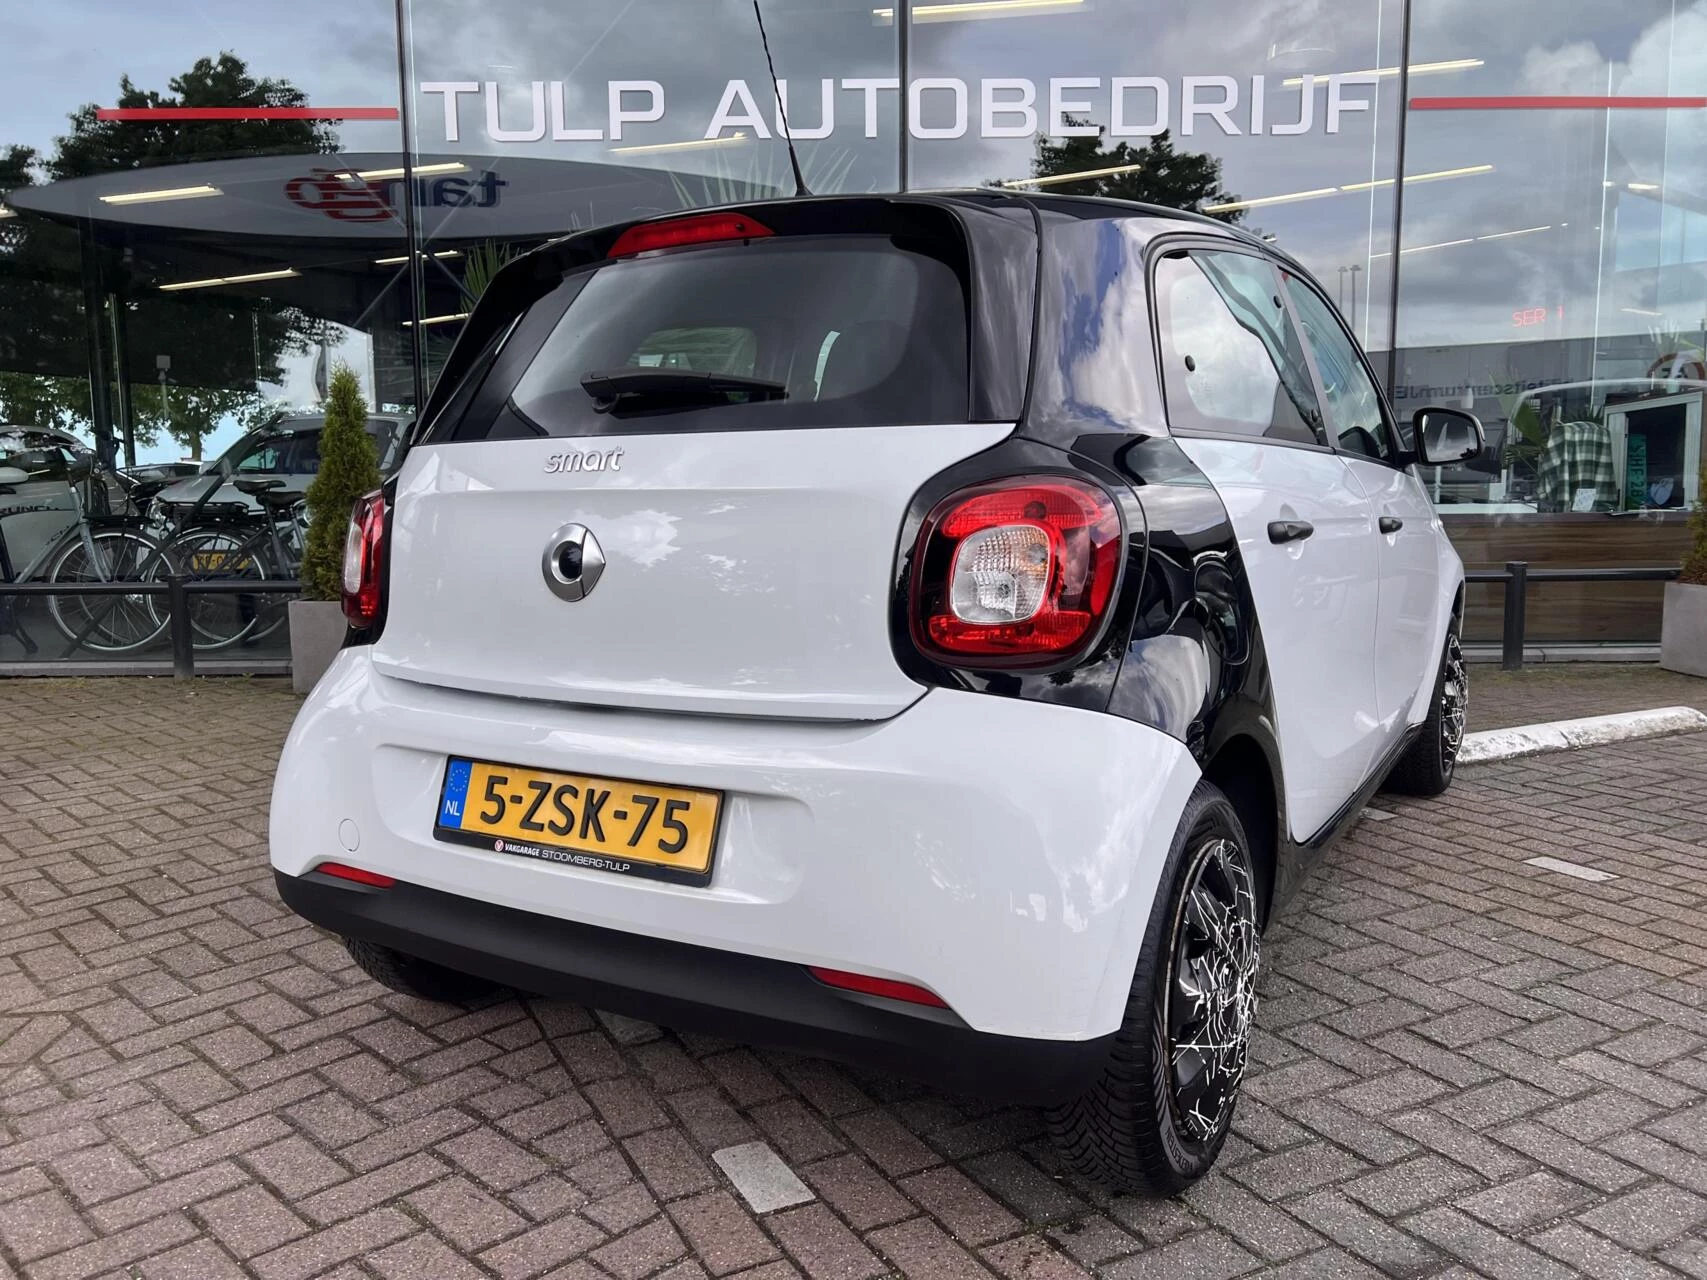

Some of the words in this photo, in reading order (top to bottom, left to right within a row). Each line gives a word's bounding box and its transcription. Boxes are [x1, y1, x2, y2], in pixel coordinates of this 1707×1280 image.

[420, 80, 665, 142] TULP
[703, 74, 1380, 140] AUTOBEDRIJF
[544, 445, 625, 473] smart
[444, 799, 461, 816] NL
[480, 775, 690, 854] 5-ZSK-75
[505, 843, 540, 857] VAKGARAGE
[542, 849, 631, 872] STOOMBERG-TULP
